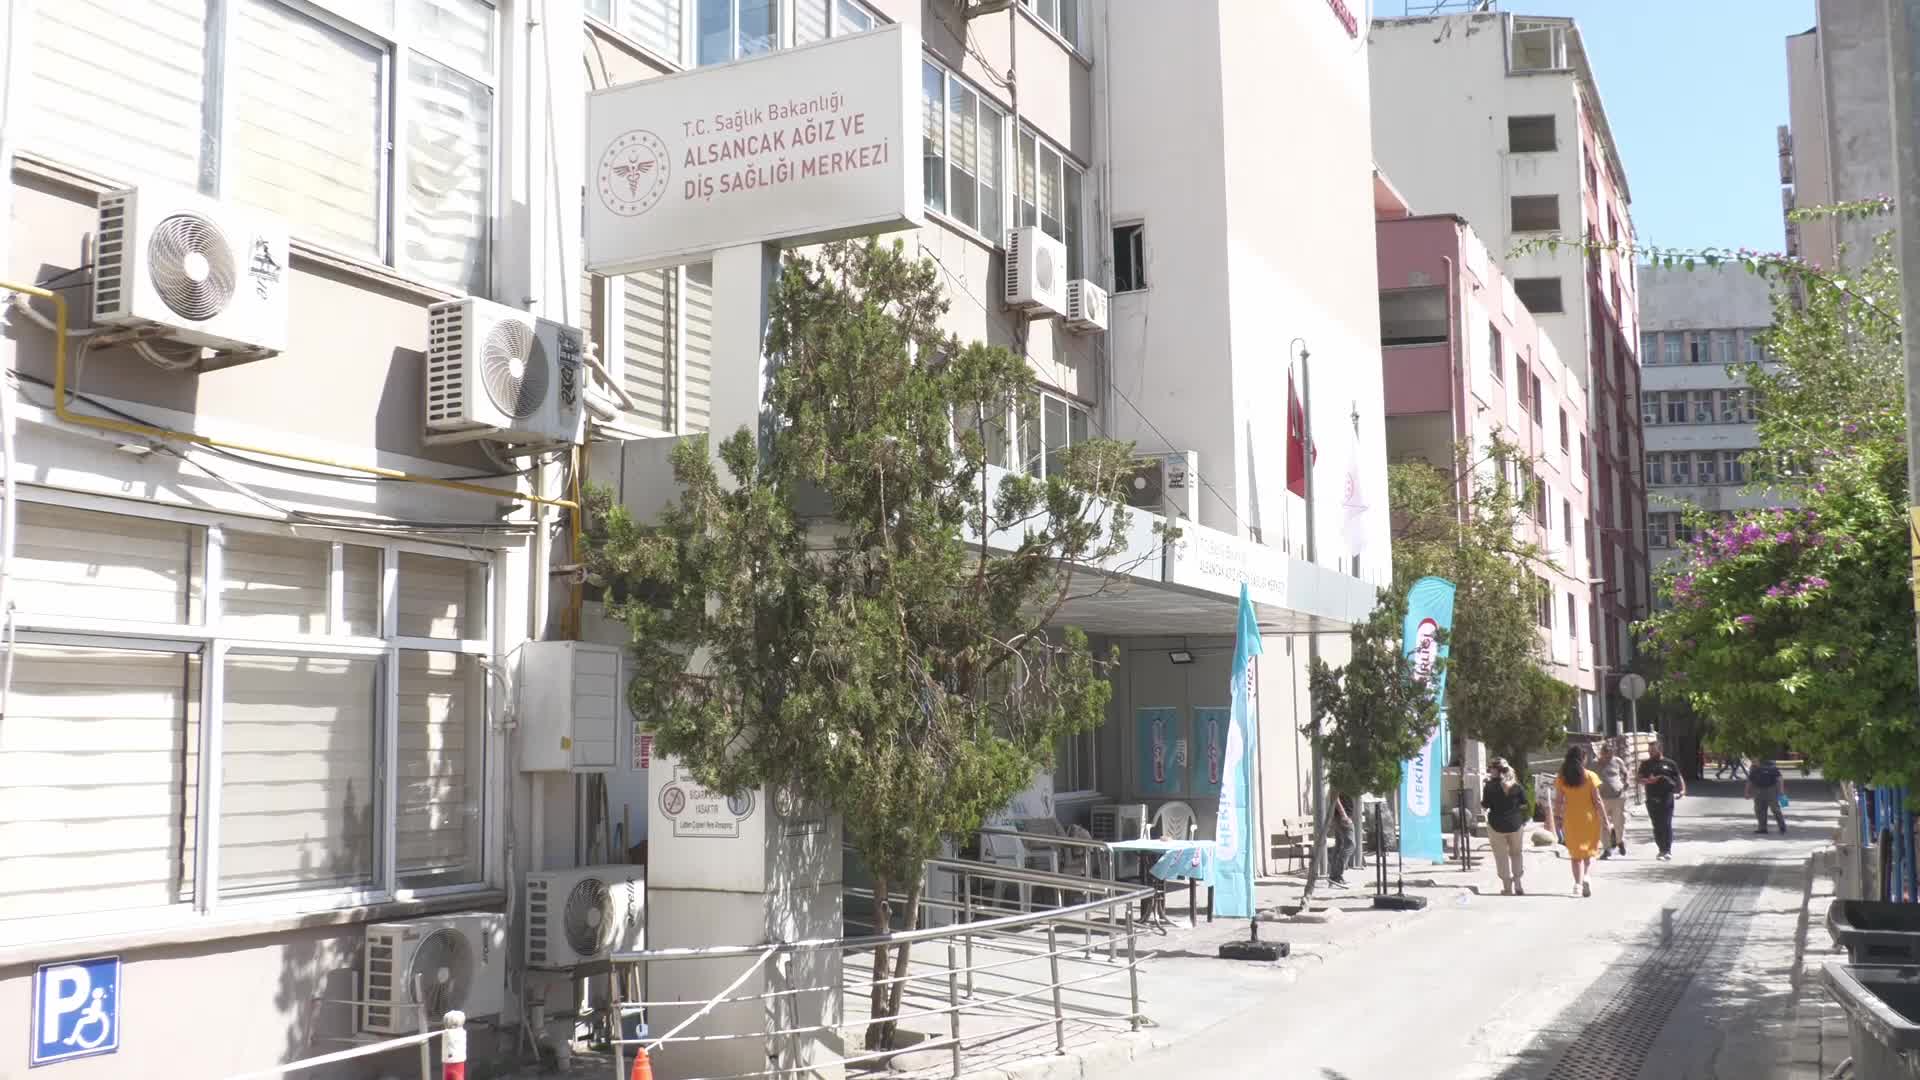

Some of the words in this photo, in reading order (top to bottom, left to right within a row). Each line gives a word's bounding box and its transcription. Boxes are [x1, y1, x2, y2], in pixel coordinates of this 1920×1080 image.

[683, 119, 711, 138] T.C.
[715, 107, 763, 133] Sağlık
[768, 91, 844, 121] Bakanlığı
[684, 129, 785, 168] ALSANCAK
[791, 117, 836, 147] AĞIZ
[840, 113, 865, 137] VE
[684, 172, 715, 203] DİŞ
[719, 156, 795, 194] SAĞLIĞI
[801, 136, 889, 179] MERKEZİ
[44, 964, 91, 1045] P
